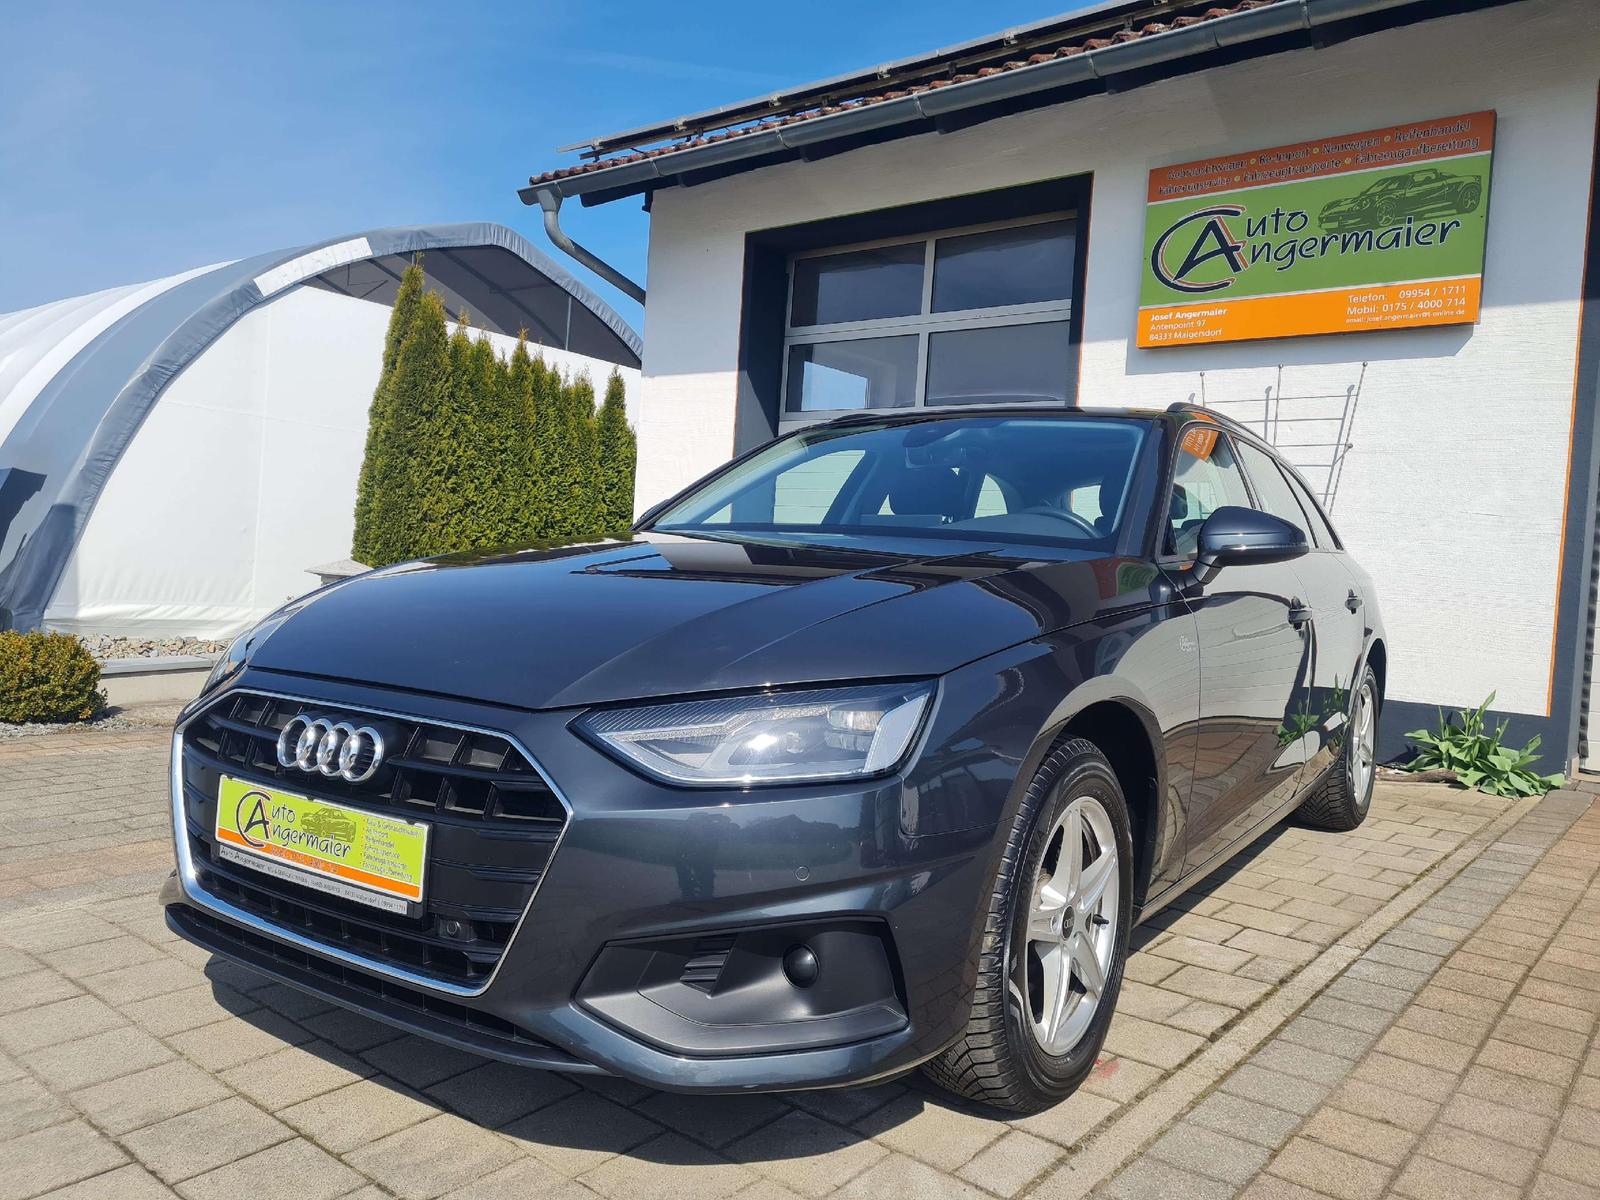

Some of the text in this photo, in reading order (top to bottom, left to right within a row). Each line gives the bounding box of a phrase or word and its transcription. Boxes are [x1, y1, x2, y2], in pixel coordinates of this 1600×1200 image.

[1322, 137, 1381, 155] Neuwagen
[1395, 120, 1471, 142] Reifenhandel
[1243, 159, 1341, 184] Fahrzeugtransporte
[1354, 137, 1480, 165] Fahrzeugaufbereitung
[1348, 294, 1387, 304] Telefon:
[1399, 288, 1430, 299] 09954
[1442, 285, 1466, 295] 1711
[1151, 308, 1228, 322] Josef Angermaier
[1347, 305, 1378, 315] Mobil:
[1382, 302, 1407, 312] 0175
[1417, 299, 1443, 309] 4000
[1447, 297, 1466, 307] 714
[1196, 319, 1207, 327] 97
